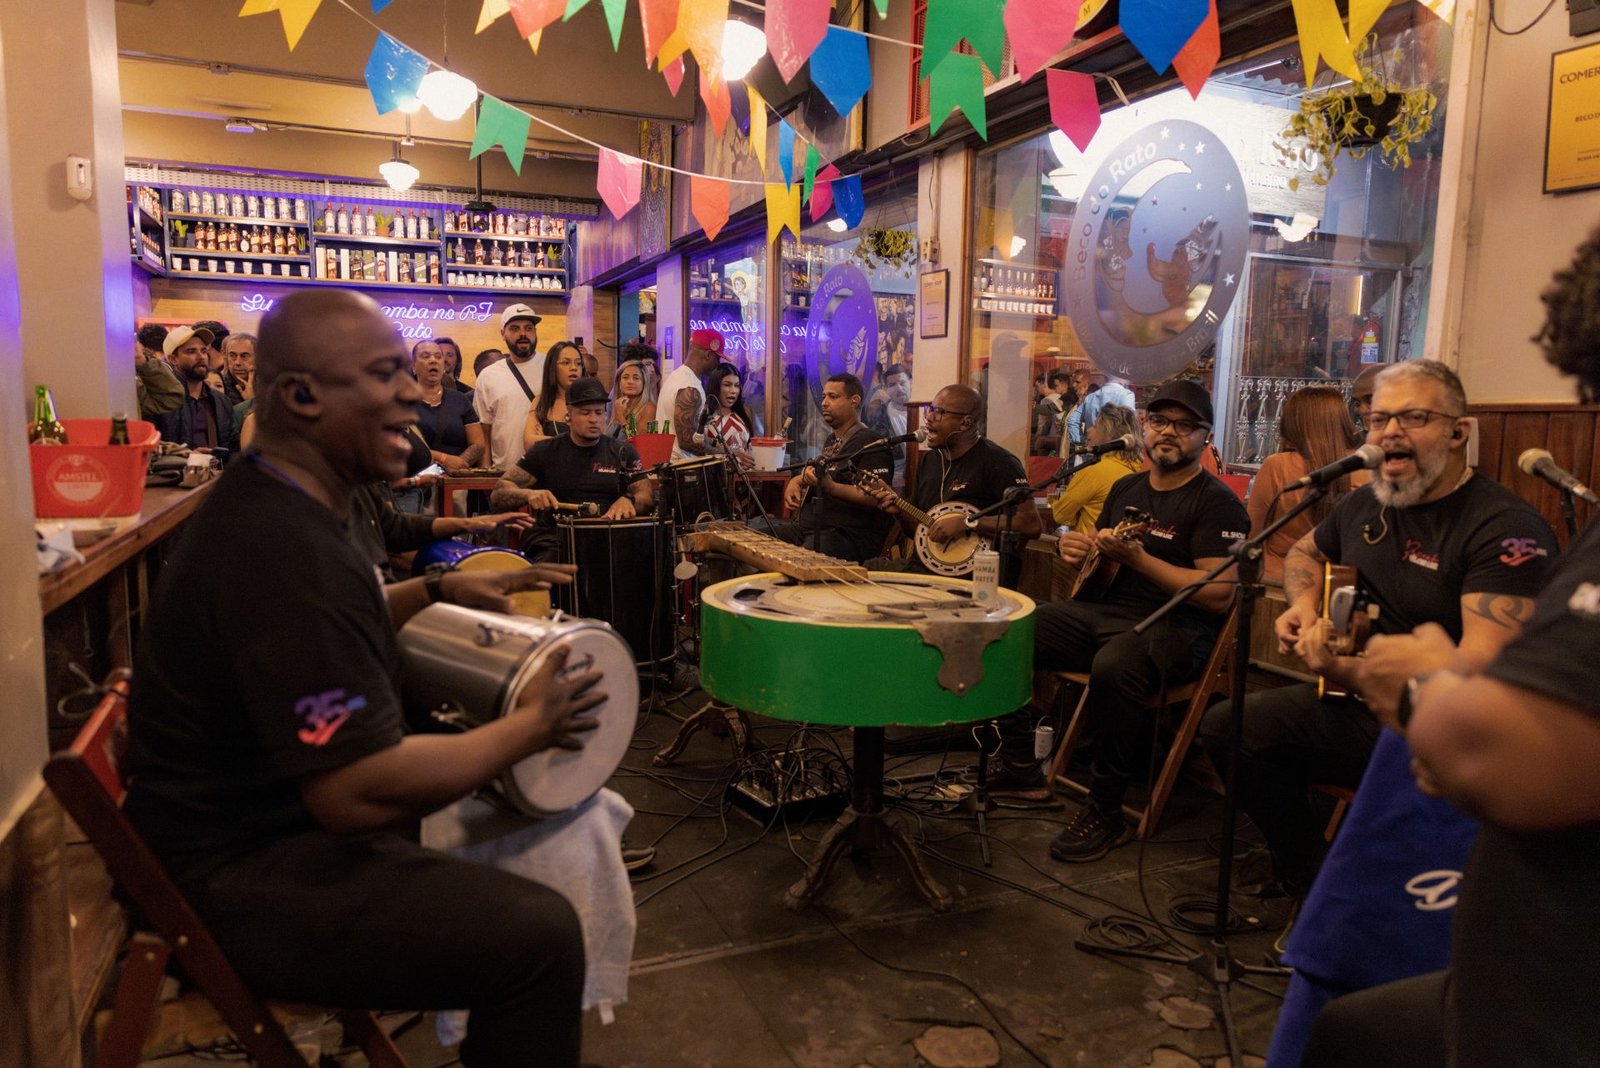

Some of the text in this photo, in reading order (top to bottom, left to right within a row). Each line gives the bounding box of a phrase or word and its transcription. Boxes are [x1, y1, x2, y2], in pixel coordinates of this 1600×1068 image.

[1108, 141, 1157, 184] Rato
[381, 302, 430, 320] mba
[433, 307, 456, 321] no
[459, 301, 493, 322] RJ
[57, 472, 97, 481] AMSTEL
